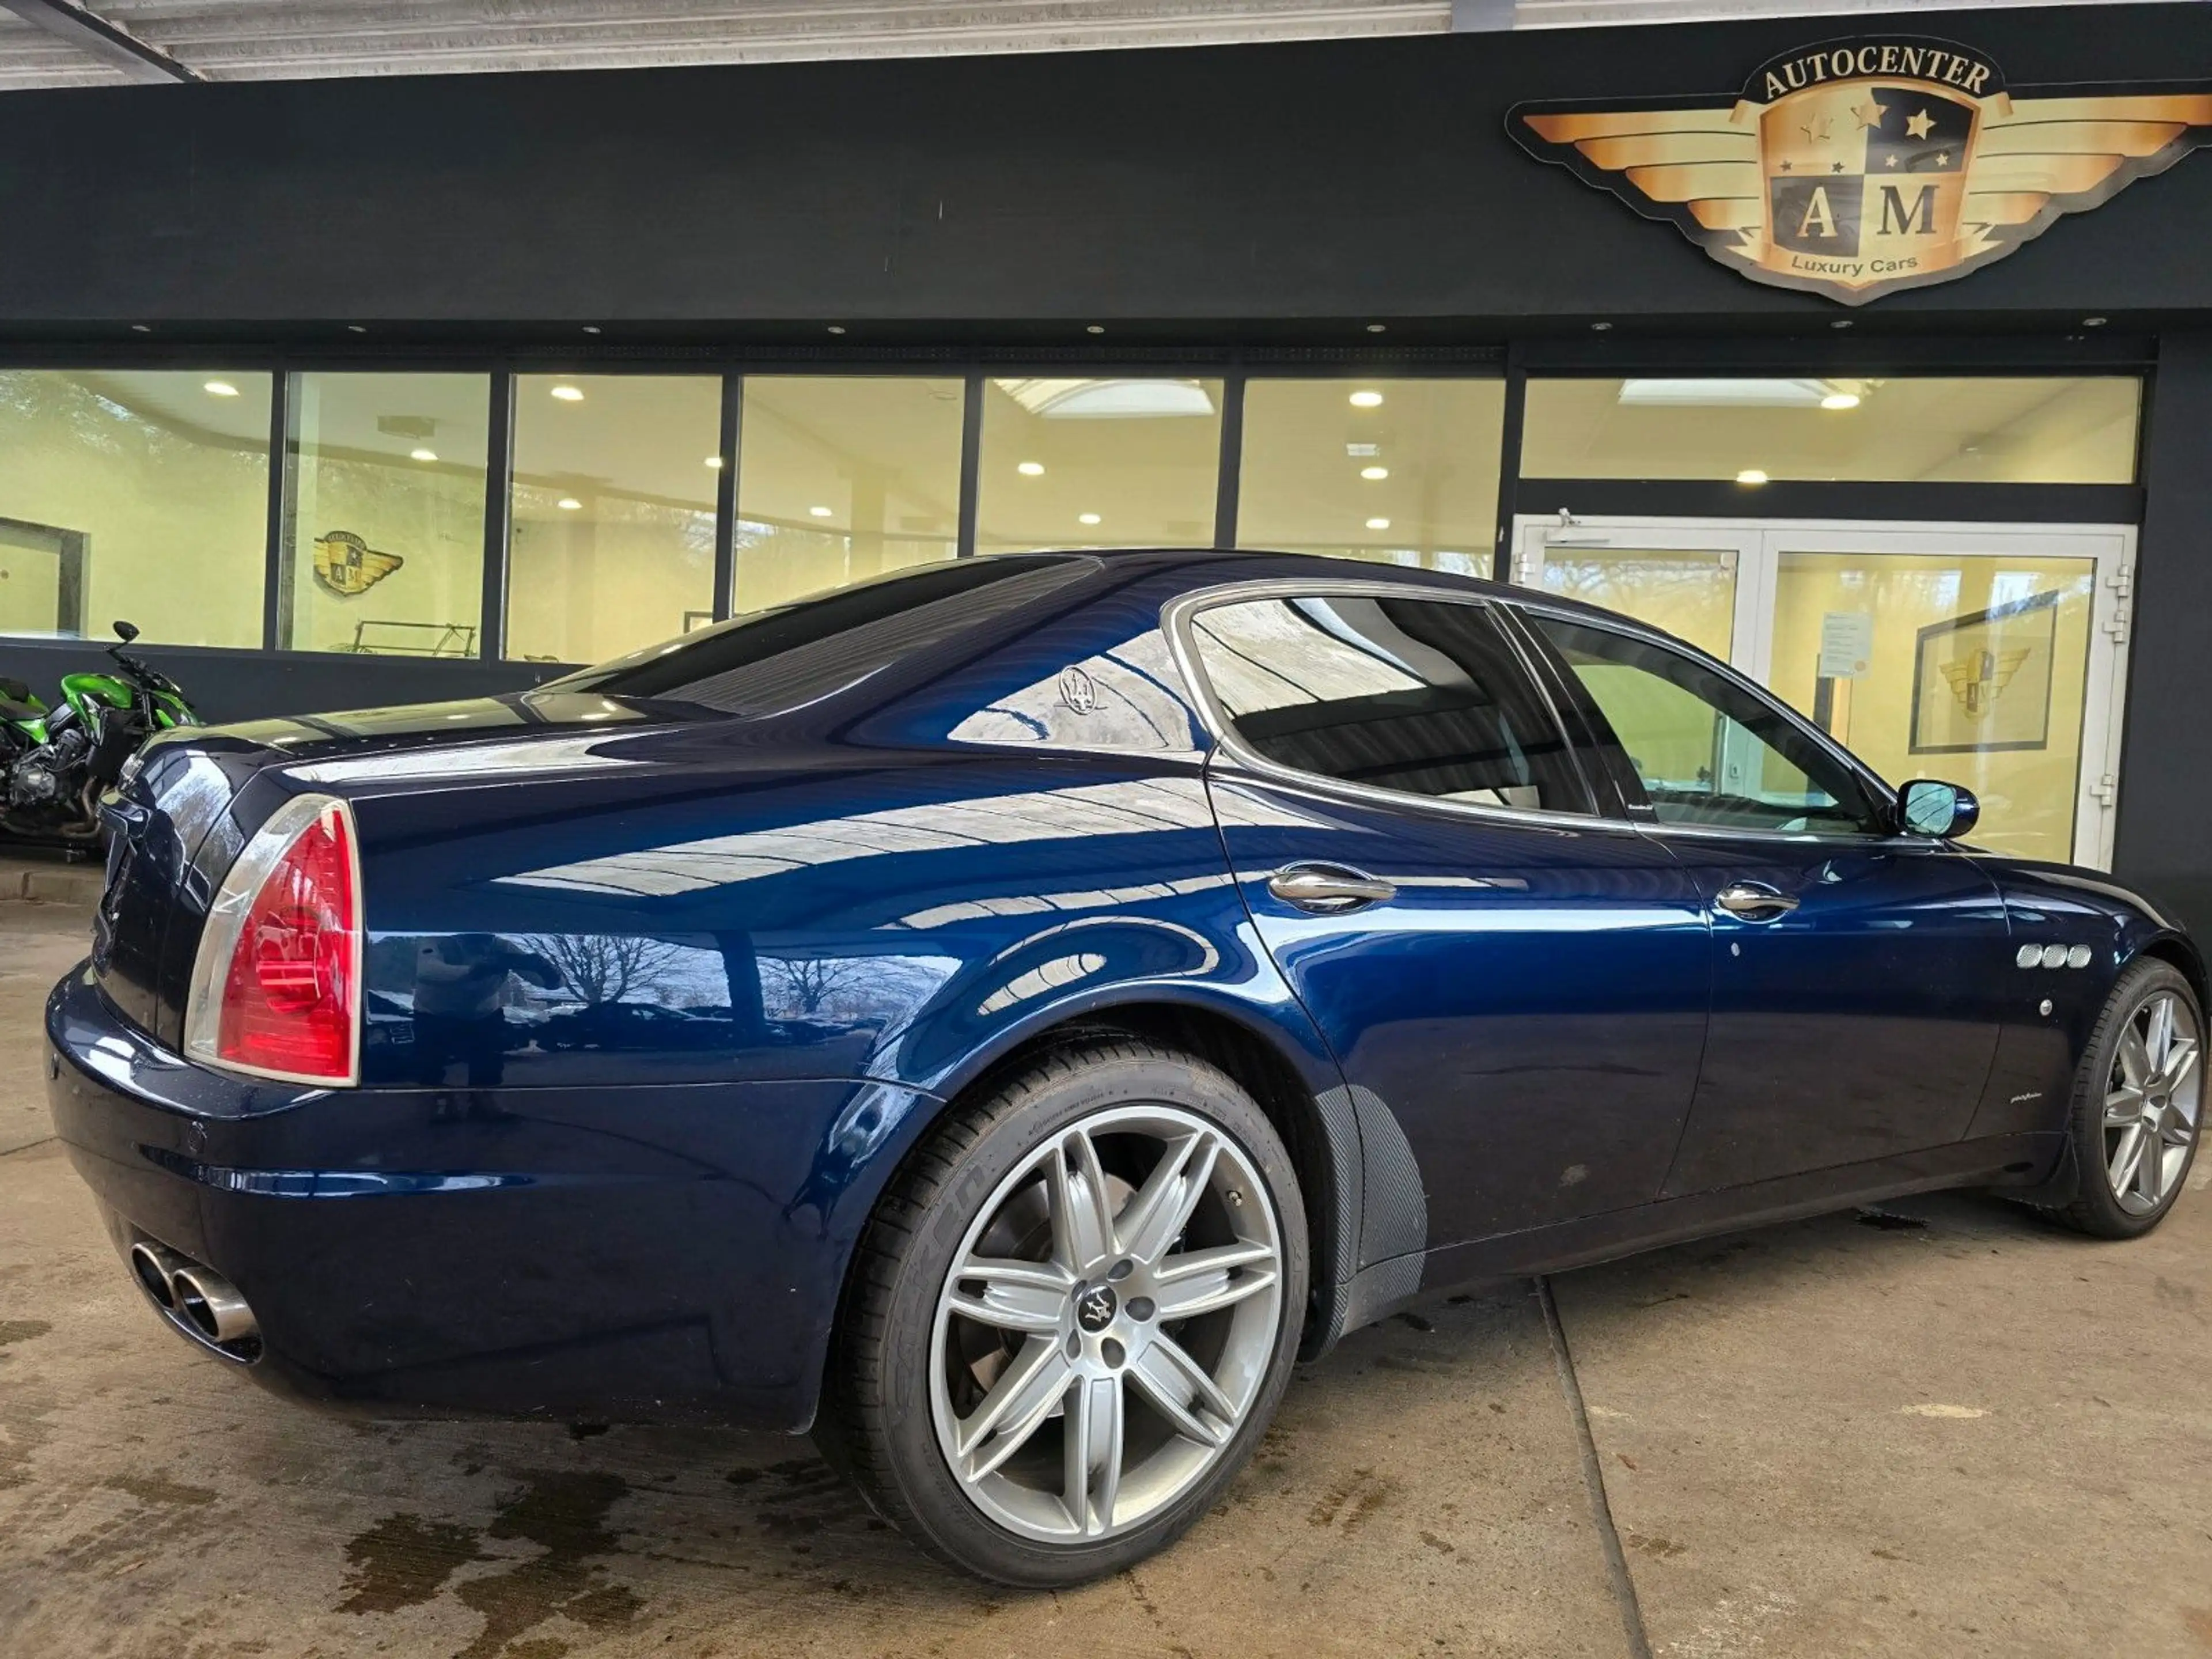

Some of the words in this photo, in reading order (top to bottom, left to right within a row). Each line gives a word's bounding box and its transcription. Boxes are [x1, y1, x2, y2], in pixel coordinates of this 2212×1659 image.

[1765, 46, 1991, 99] AUTOCENTER
[1797, 186, 1838, 237] A
[1876, 184, 1940, 234] M
[1791, 256, 1863, 277] Luxury
[1870, 257, 1918, 273] Cars
